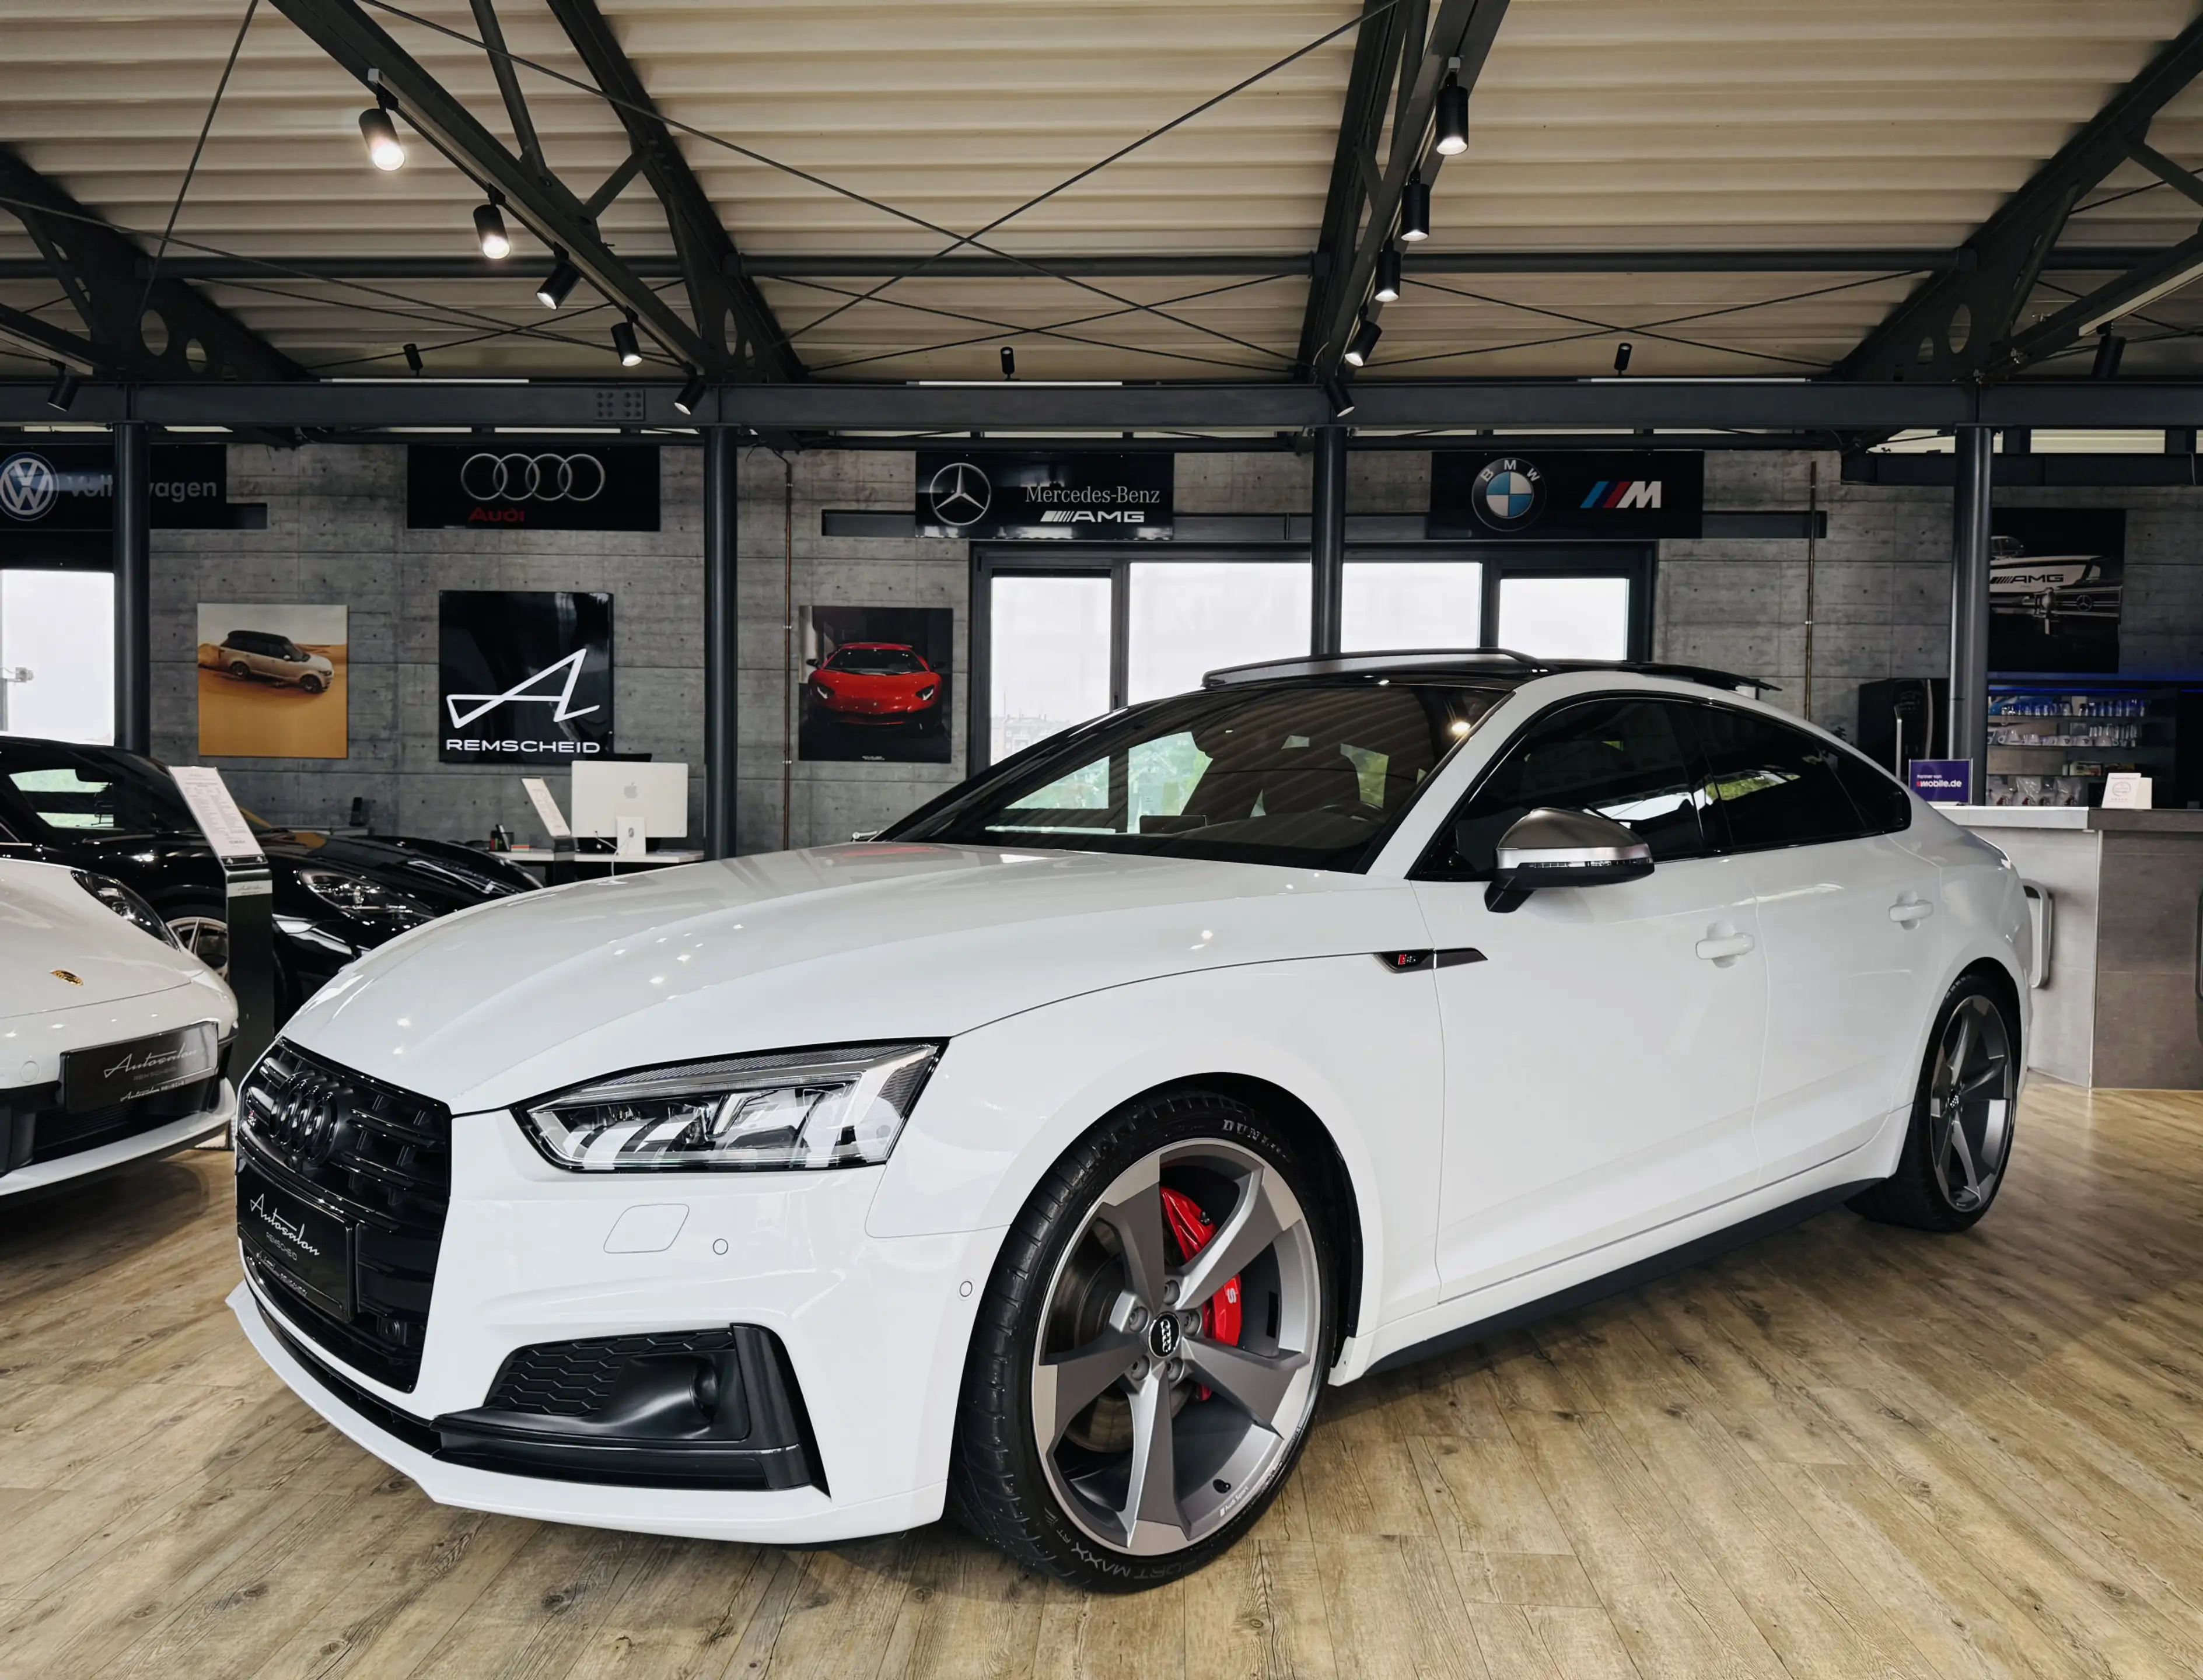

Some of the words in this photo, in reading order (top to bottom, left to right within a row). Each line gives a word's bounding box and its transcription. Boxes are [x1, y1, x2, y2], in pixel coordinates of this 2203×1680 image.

[1480, 460, 1540, 482] BMW
[1025, 486, 1160, 503] Mercedes-Benz
[468, 506, 524, 522] Audi
[1071, 510, 1145, 523] AMG
[2012, 574, 2064, 584] AMG
[446, 739, 600, 754] REMSCHEID
[1917, 779, 1962, 788] mobile.de
[250, 1193, 320, 1256] Autosalon
